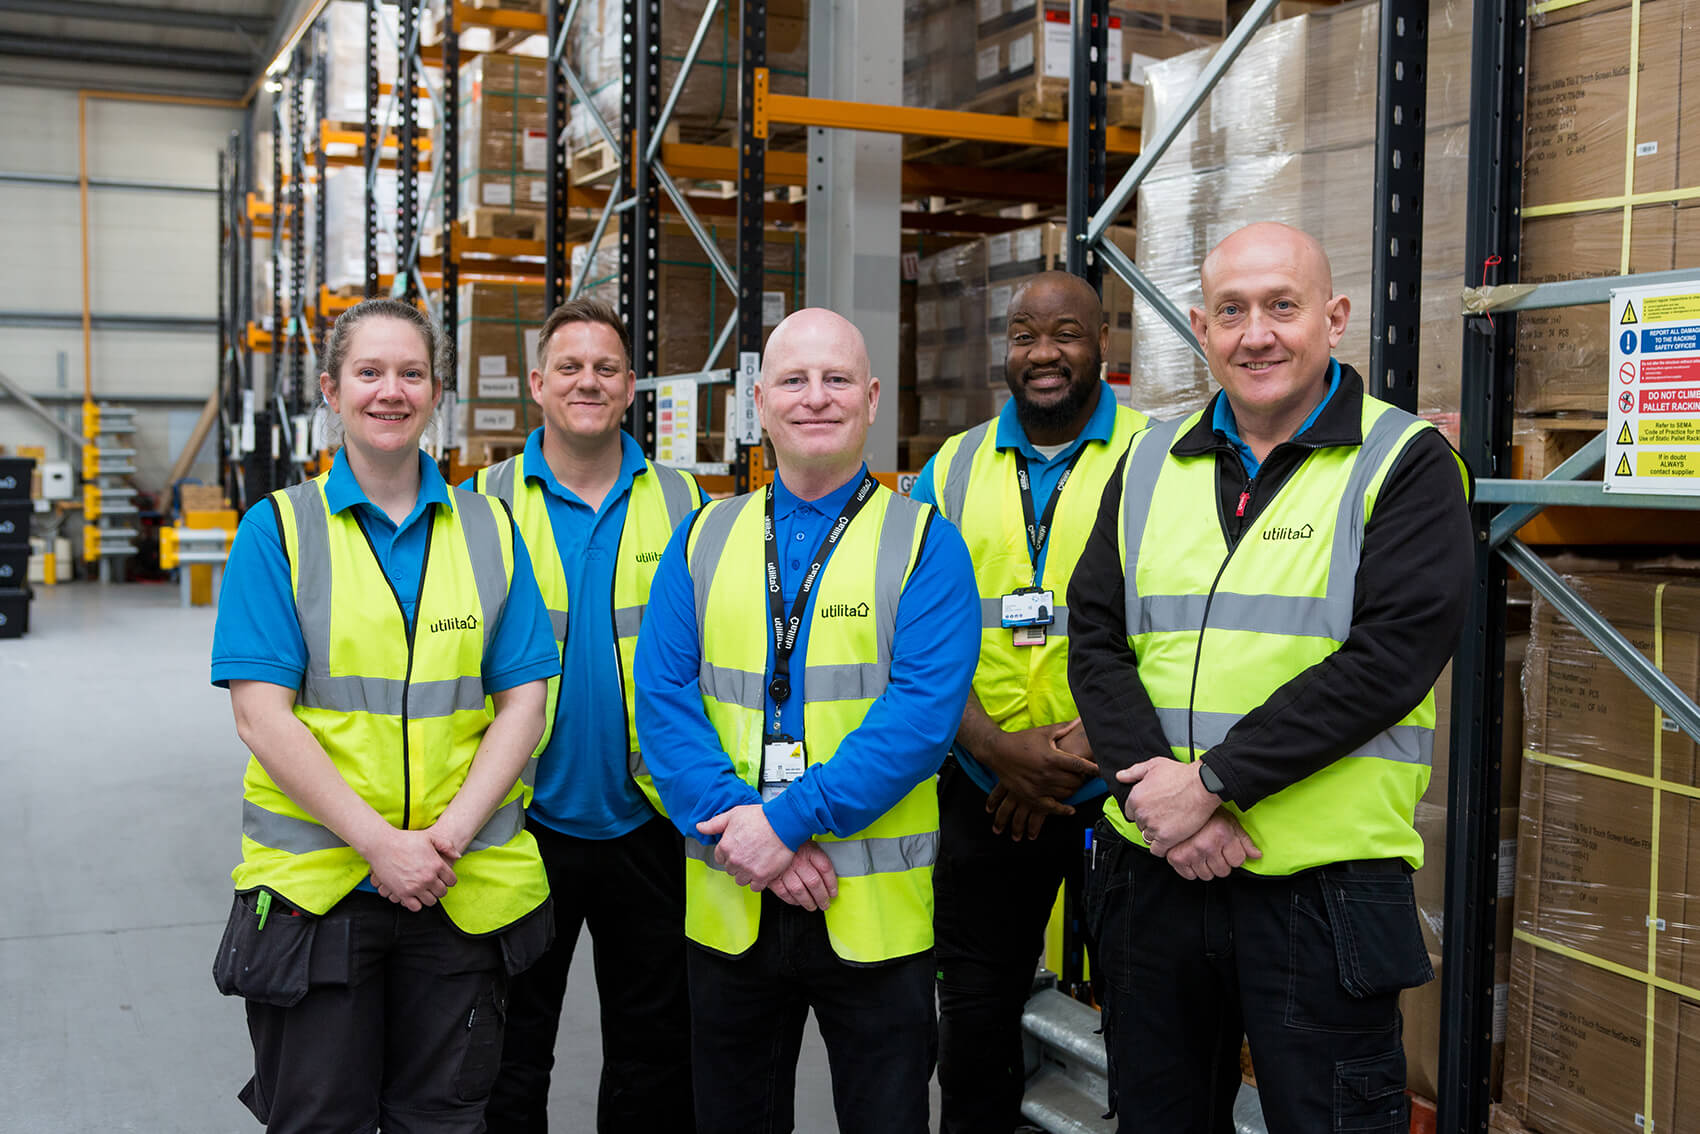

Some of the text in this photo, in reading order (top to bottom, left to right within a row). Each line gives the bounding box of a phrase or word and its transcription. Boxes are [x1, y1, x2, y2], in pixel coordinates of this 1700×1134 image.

[1673, 334, 1696, 342] RACKING
[1655, 342, 1696, 351] SAFETY OFFICER
[746, 366, 754, 376] D
[746, 387, 754, 397] C
[1648, 391, 1659, 400] DO
[1660, 391, 1676, 400] NOT
[1643, 402, 1670, 412] PALLET
[746, 432, 754, 441] A
[829, 521, 845, 543] utilita
[1263, 528, 1300, 541] utilita
[768, 562, 776, 586] utilita
[803, 569, 818, 592] utilita
[821, 604, 857, 618] utilita
[430, 618, 468, 633] utilita
[774, 618, 784, 644] utilita
[785, 625, 799, 650] utilita
